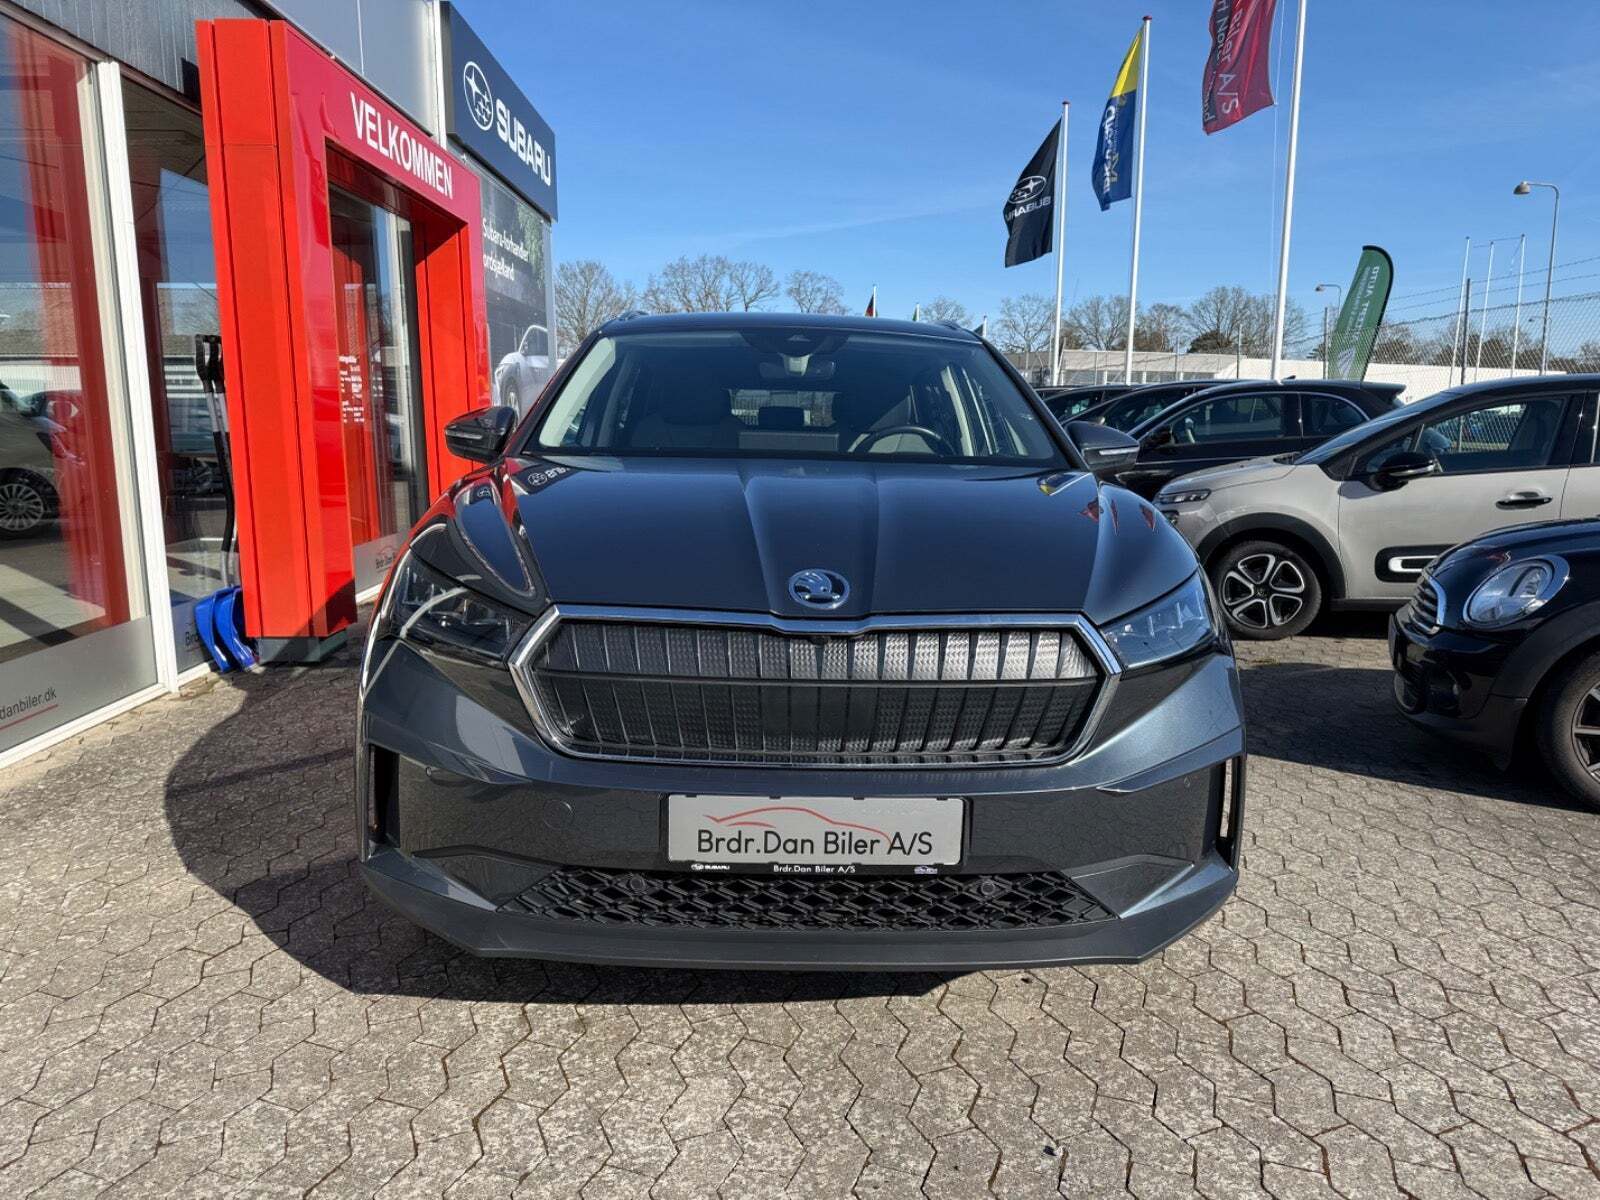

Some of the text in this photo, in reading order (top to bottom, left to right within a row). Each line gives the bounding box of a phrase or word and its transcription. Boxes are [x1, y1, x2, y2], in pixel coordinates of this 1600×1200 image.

[1217, 73, 1239, 114] A/S
[350, 91, 453, 200] VELKOMMEN
[496, 98, 551, 187] SUBARU
[482, 252, 515, 281] ordsjælland
[698, 829, 932, 856] Brdr.Dan Biler A/S
[773, 864, 856, 874] Brdr.Dan Biler A/S
